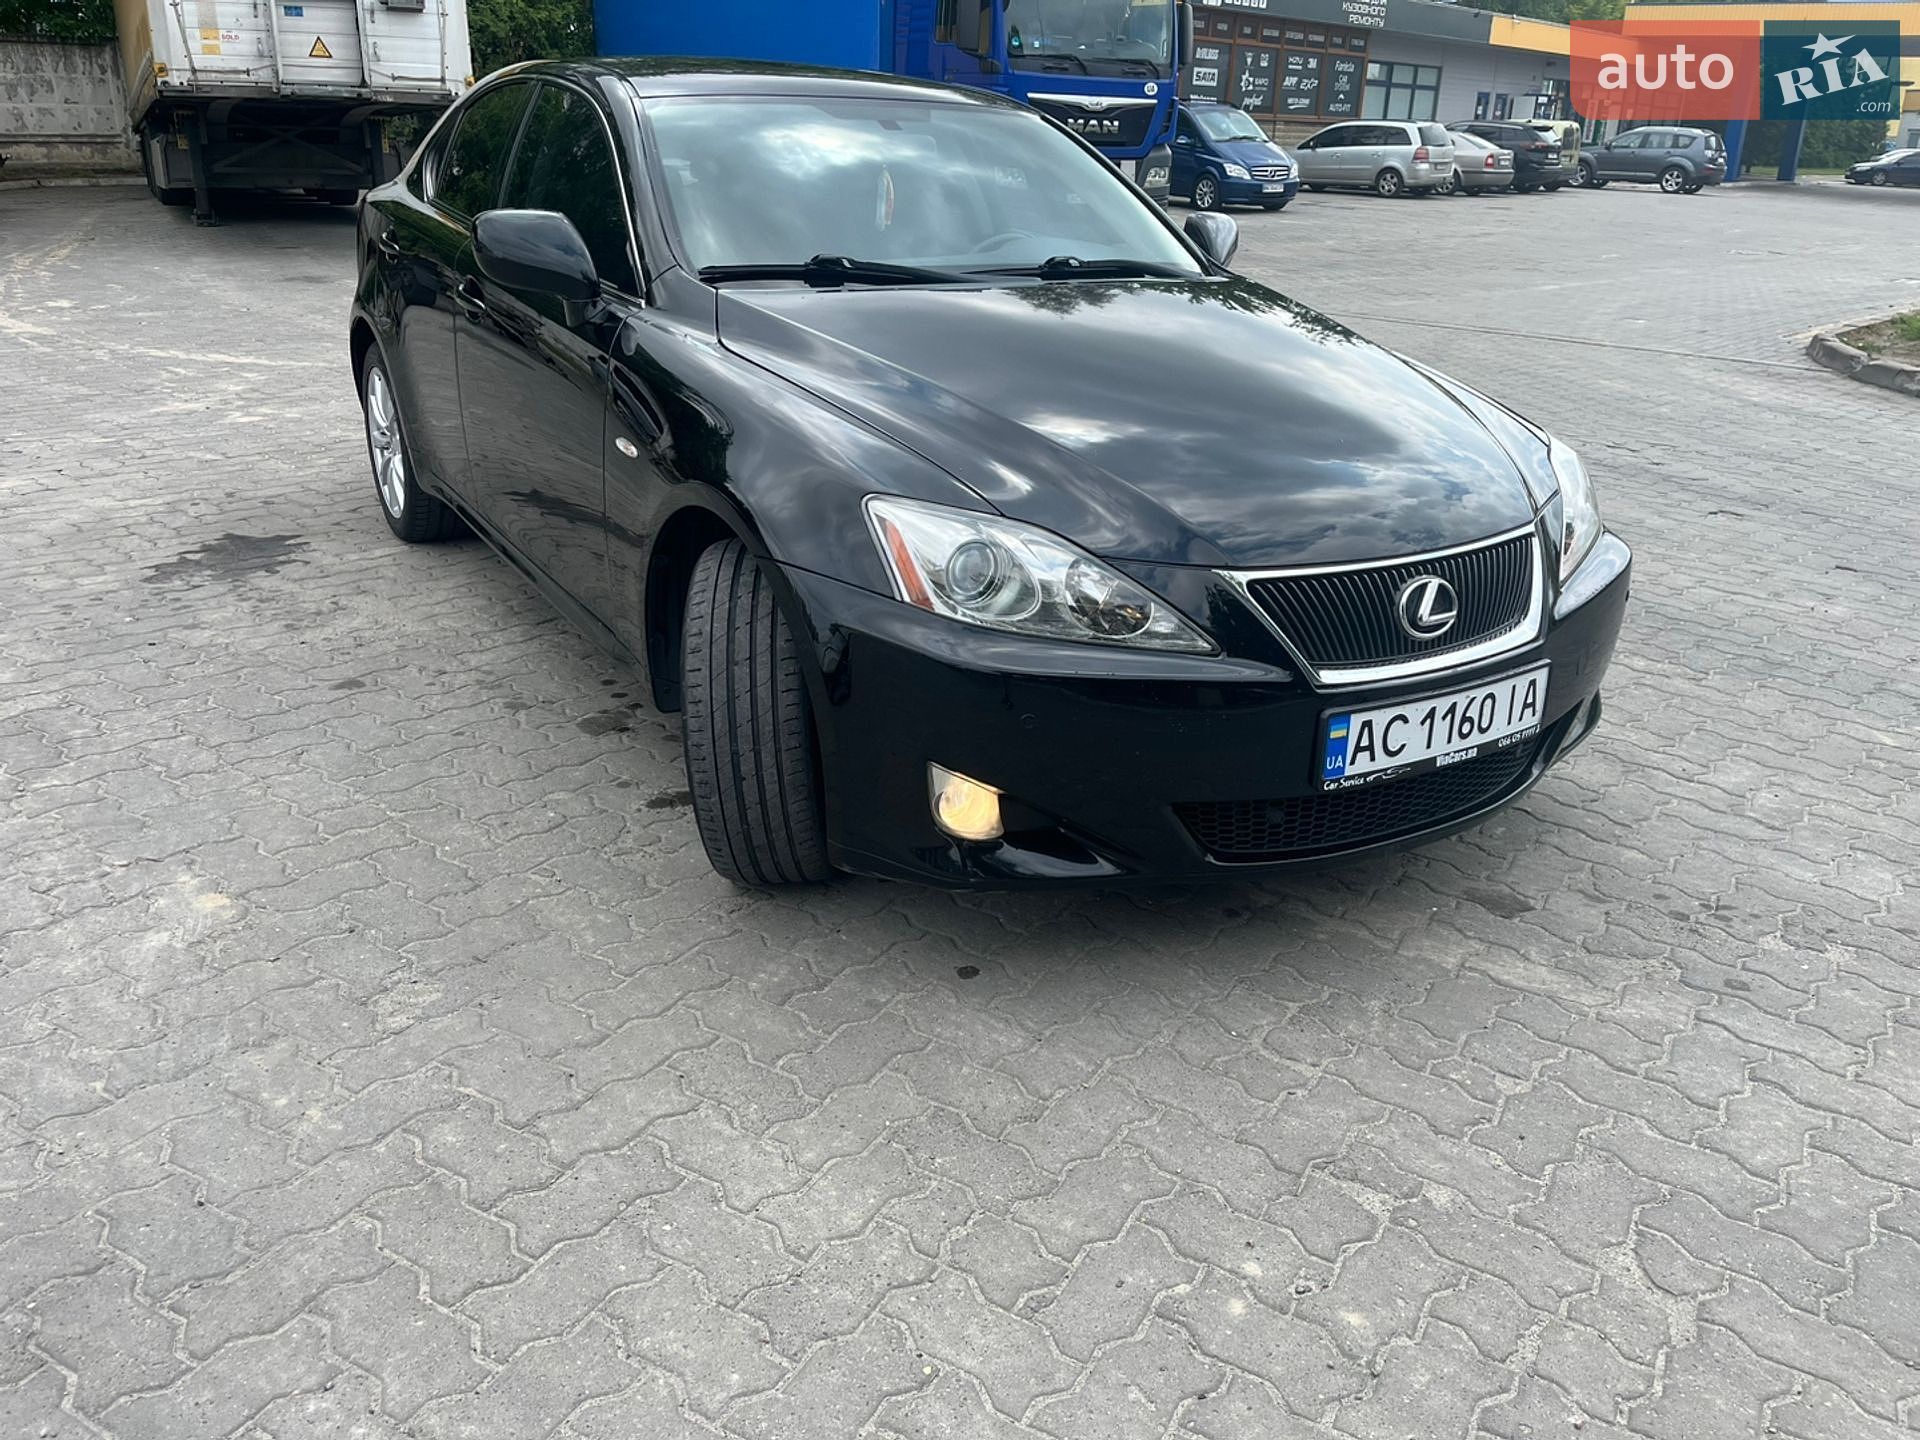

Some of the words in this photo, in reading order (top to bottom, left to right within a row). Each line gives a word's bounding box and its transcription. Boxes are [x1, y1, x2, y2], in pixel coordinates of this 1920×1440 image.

[1349, 14, 1385, 28] РЕМОНТУ
[1195, 71, 1216, 82] SATA
[1067, 118, 1119, 134] MAN
[1349, 713, 1410, 767] AC
[1420, 692, 1496, 749] 1160
[1506, 677, 1539, 727] IA
[1326, 755, 1343, 770] UA
[1323, 780, 1338, 791] Car
